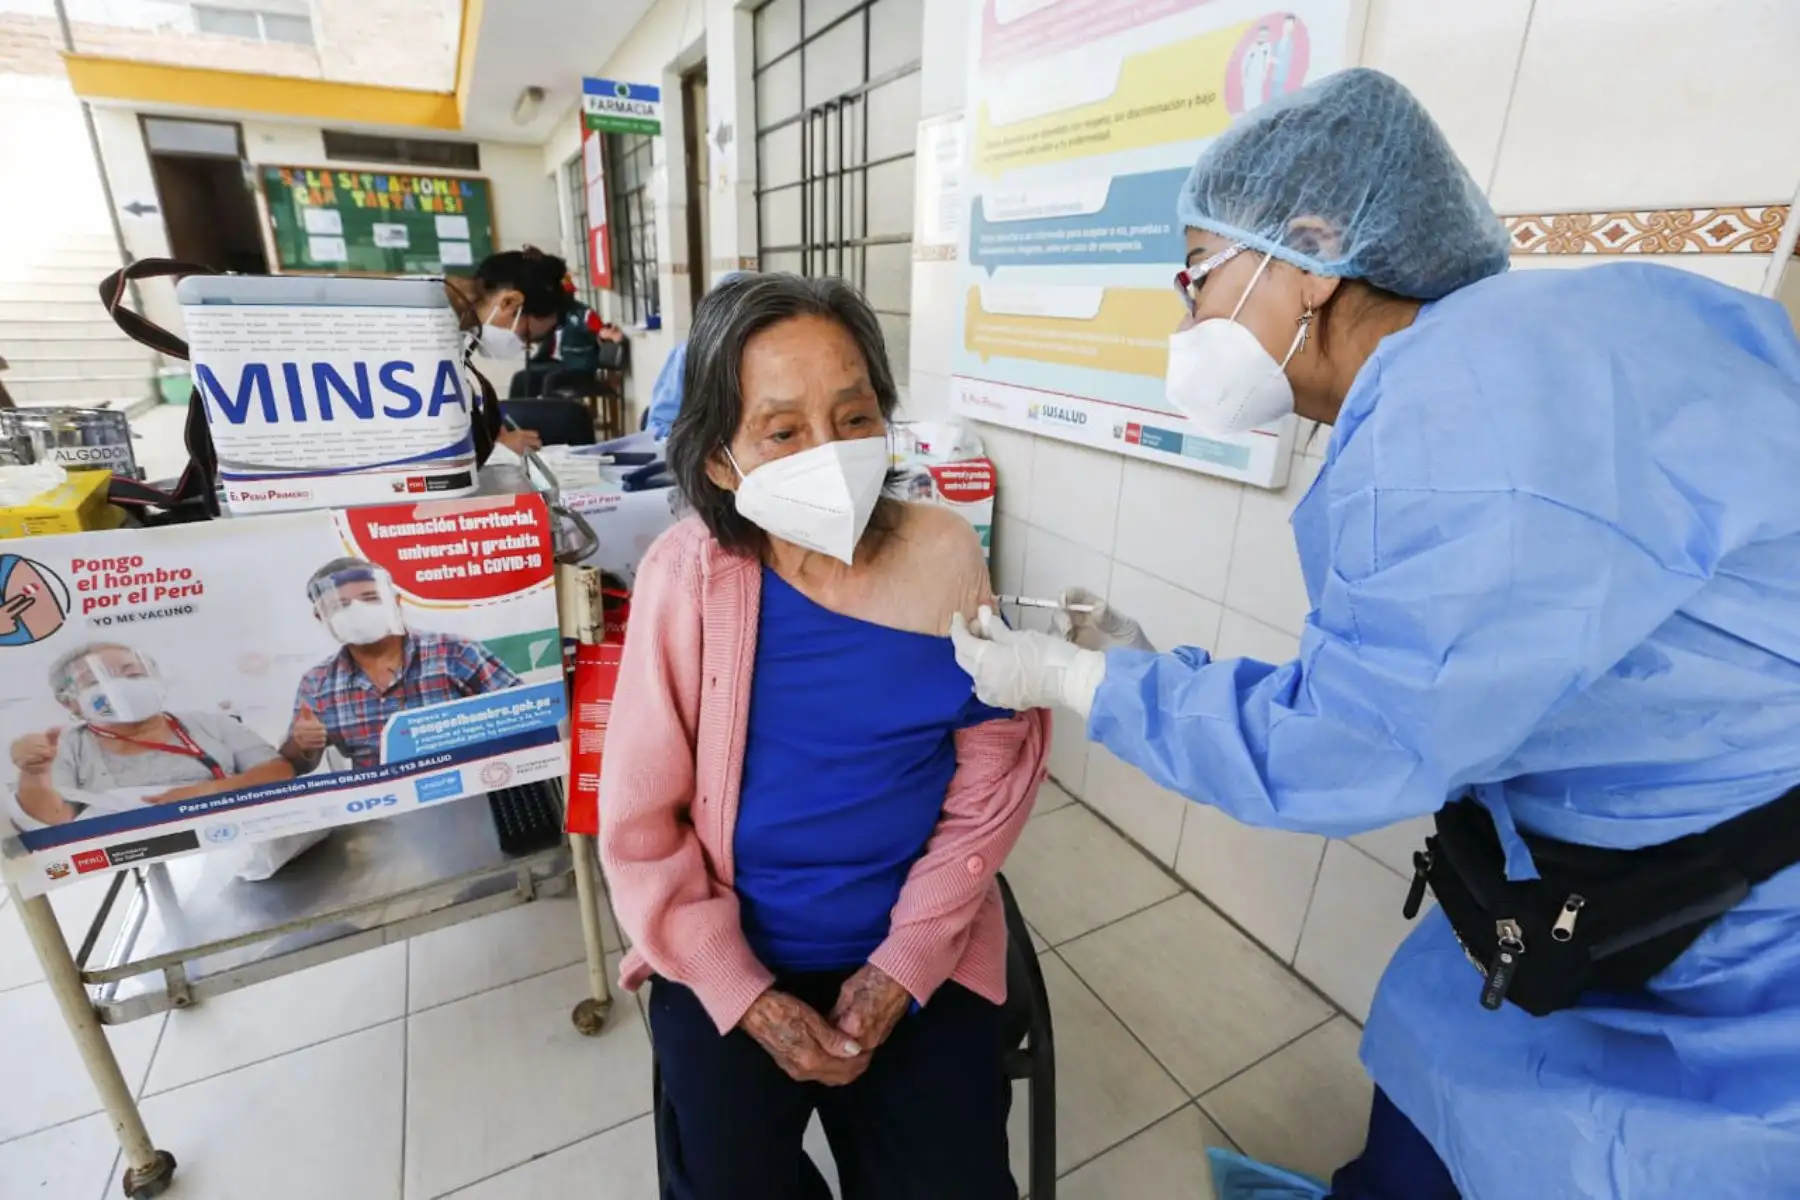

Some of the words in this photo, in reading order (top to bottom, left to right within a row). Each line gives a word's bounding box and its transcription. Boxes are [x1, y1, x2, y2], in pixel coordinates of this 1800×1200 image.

[590, 97, 655, 115] FARMACIA
[195, 359, 467, 425] MINSA
[1042, 404, 1088, 426] SUSALUD
[55, 447, 128, 461] ALGODON
[367, 517, 457, 539] Vacunación
[458, 509, 538, 532] territorial,
[398, 539, 469, 560] universal
[469, 541, 479, 557] y
[481, 533, 540, 555] gratuita
[71, 555, 144, 574] Pongo
[415, 564, 467, 582] contra
[467, 561, 482, 576] la
[483, 554, 542, 574] COVID-19
[77, 574, 98, 591] el
[104, 567, 193, 589] hombro
[82, 593, 122, 615] por
[127, 587, 148, 604] el
[154, 580, 204, 601] Perú
[93, 616, 112, 627] YO
[117, 613, 135, 624] ME
[138, 605, 193, 620] VACUNO
[178, 802, 208, 814] Para
[210, 796, 235, 809] más
[236, 783, 306, 803] información
[308, 778, 337, 789] llama
[338, 771, 378, 784] GRATIS
[379, 768, 389, 778] al
[399, 761, 417, 773] 113
[418, 754, 452, 768] SALUD
[420, 777, 448, 791] unicef
[346, 793, 398, 813] OPS
[77, 855, 104, 867] PERÚ
